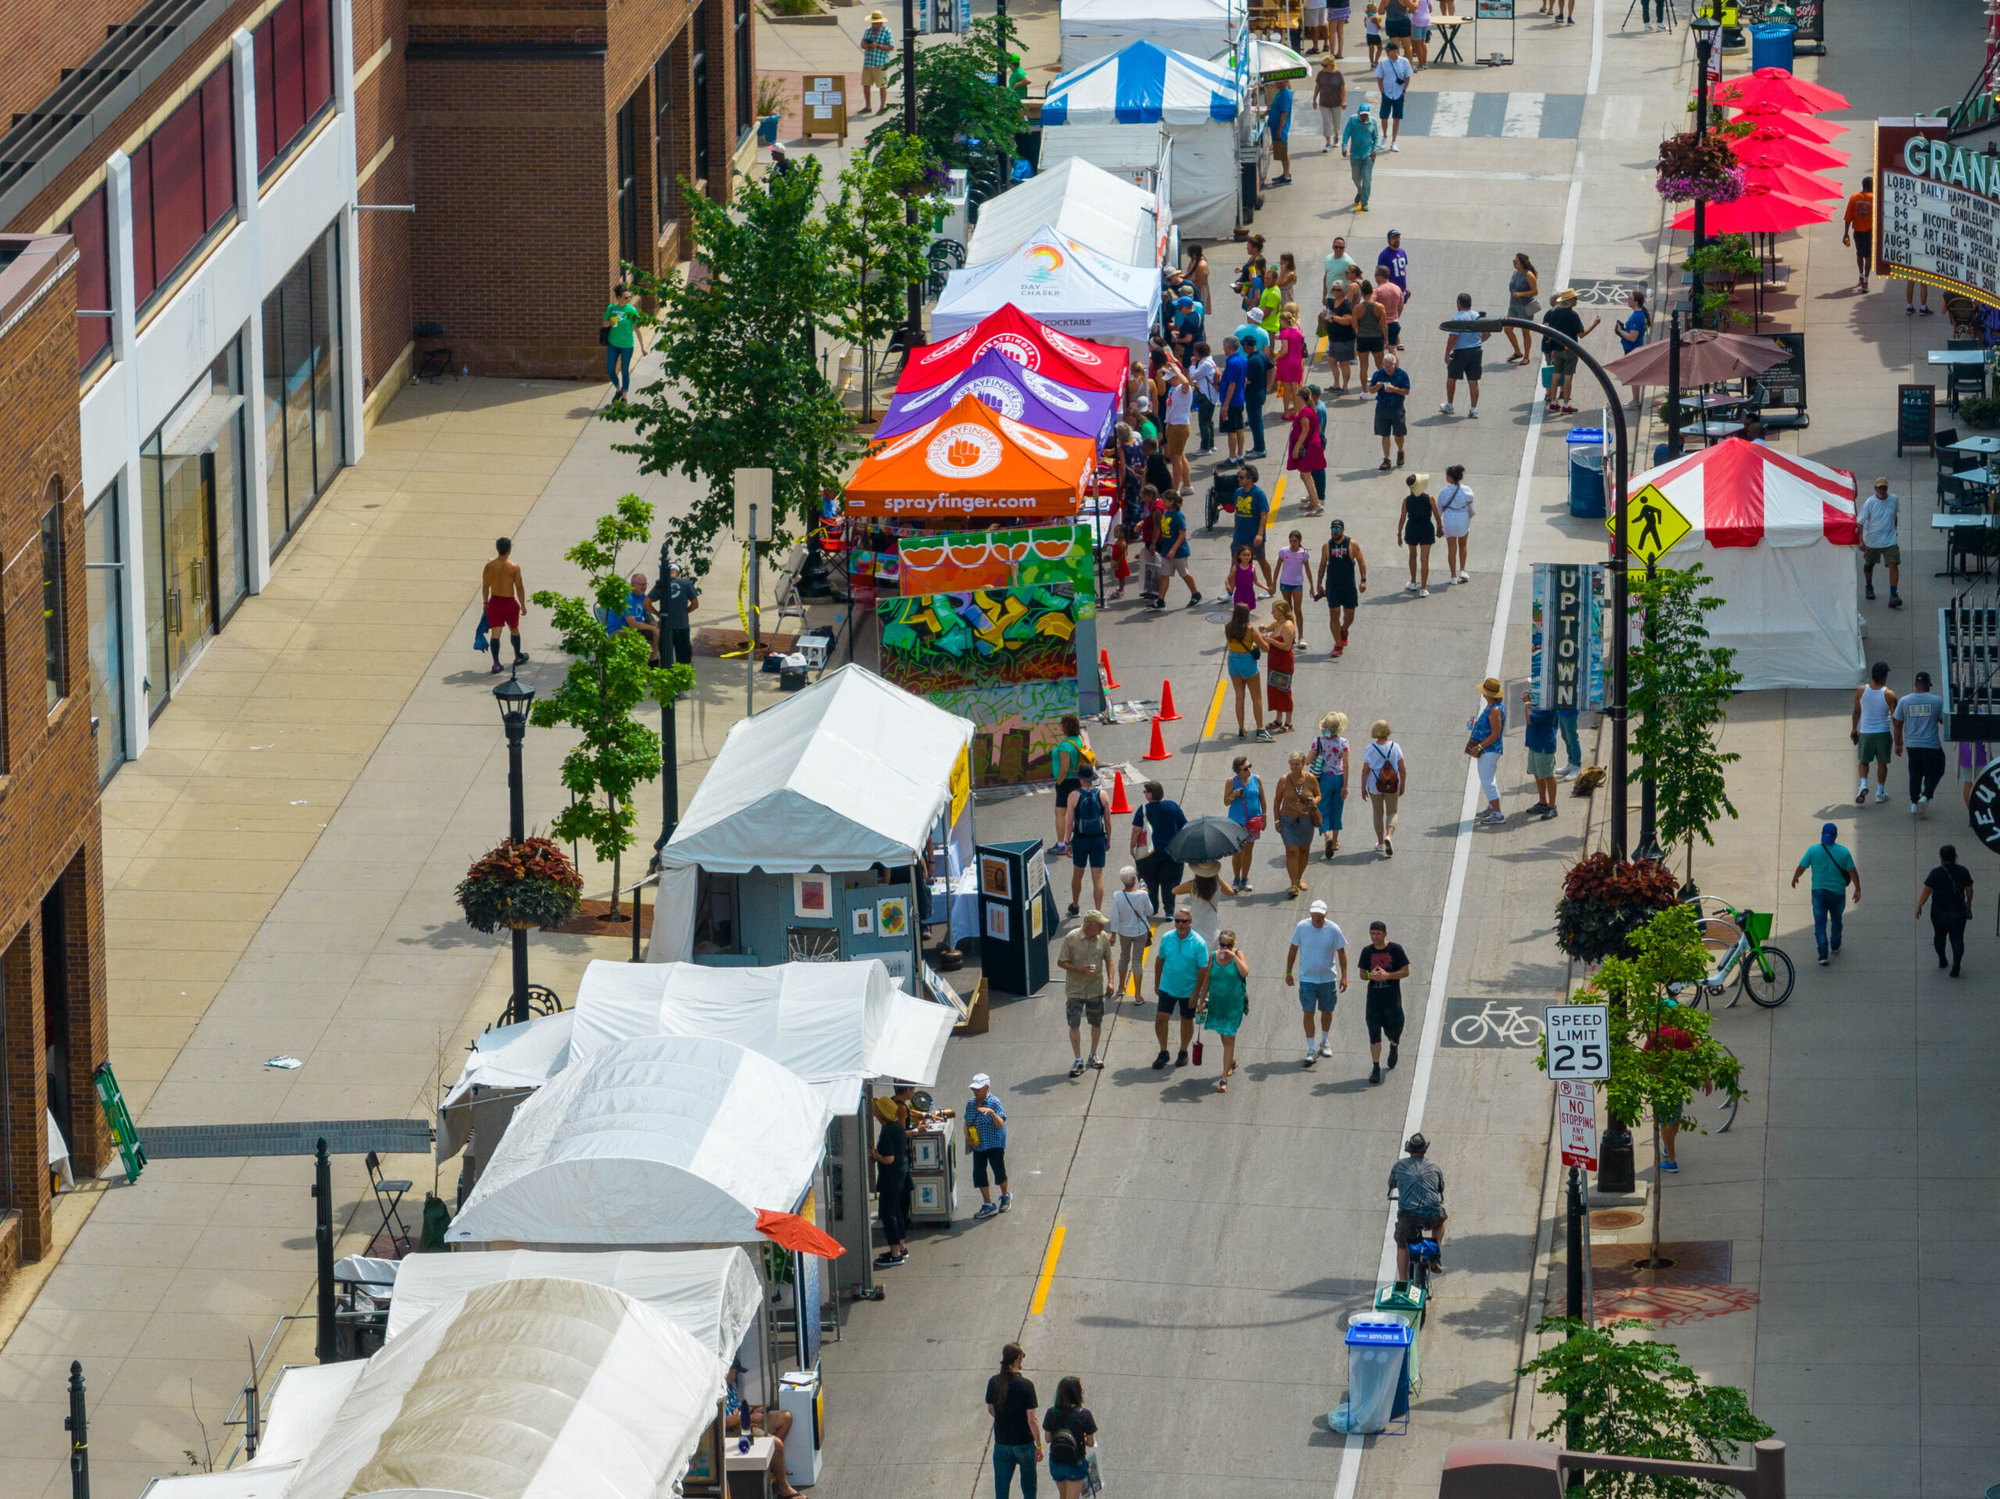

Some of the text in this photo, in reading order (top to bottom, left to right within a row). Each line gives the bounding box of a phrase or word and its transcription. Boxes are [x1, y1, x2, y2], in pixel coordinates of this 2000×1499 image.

[1797, 16, 1814, 28] OFF
[1266, 68, 1306, 81] LEMONADE
[1887, 174, 1917, 192] LOBBY
[1920, 182, 1945, 199] DAILY
[1947, 189, 1971, 208] HAPPY
[1894, 206, 1908, 220] 8-6
[1922, 212, 1958, 234] NICOTINE
[1961, 223, 1993, 247] ADDICTION
[1950, 205, 1993, 231] CANDLELIGHT
[1884, 233, 1910, 250] AUG-9
[1925, 242, 1965, 265] LONESOME
[1966, 254, 1979, 270] DAN
[1894, 220, 1998, 264] 8-4.6 ART FAIR SPECIALS
[1392, 257, 1406, 277] 19
[1884, 248, 1912, 265] AUG-11
[1936, 260, 1959, 278] SALSA
[1044, 319, 1092, 327] COCKTAILS
[977, 334, 1036, 356] SPRAYFINGER
[956, 378, 1020, 400] SPRAYFINGER
[932, 425, 998, 448] SPRAYFINGER
[883, 492, 1037, 513] sprayfinger.com
[1557, 569, 1577, 705] UPTOWN
[1551, 1014, 1602, 1026] SPEED
[1557, 1029, 1597, 1041] LIMIT
[1553, 1044, 1603, 1071] 25
[1569, 1099, 1585, 1115] NO
[1561, 1113, 1594, 1129] STOPPING
[1572, 1127, 1584, 1135] ANY
[1572, 1134, 1585, 1144] TIME
